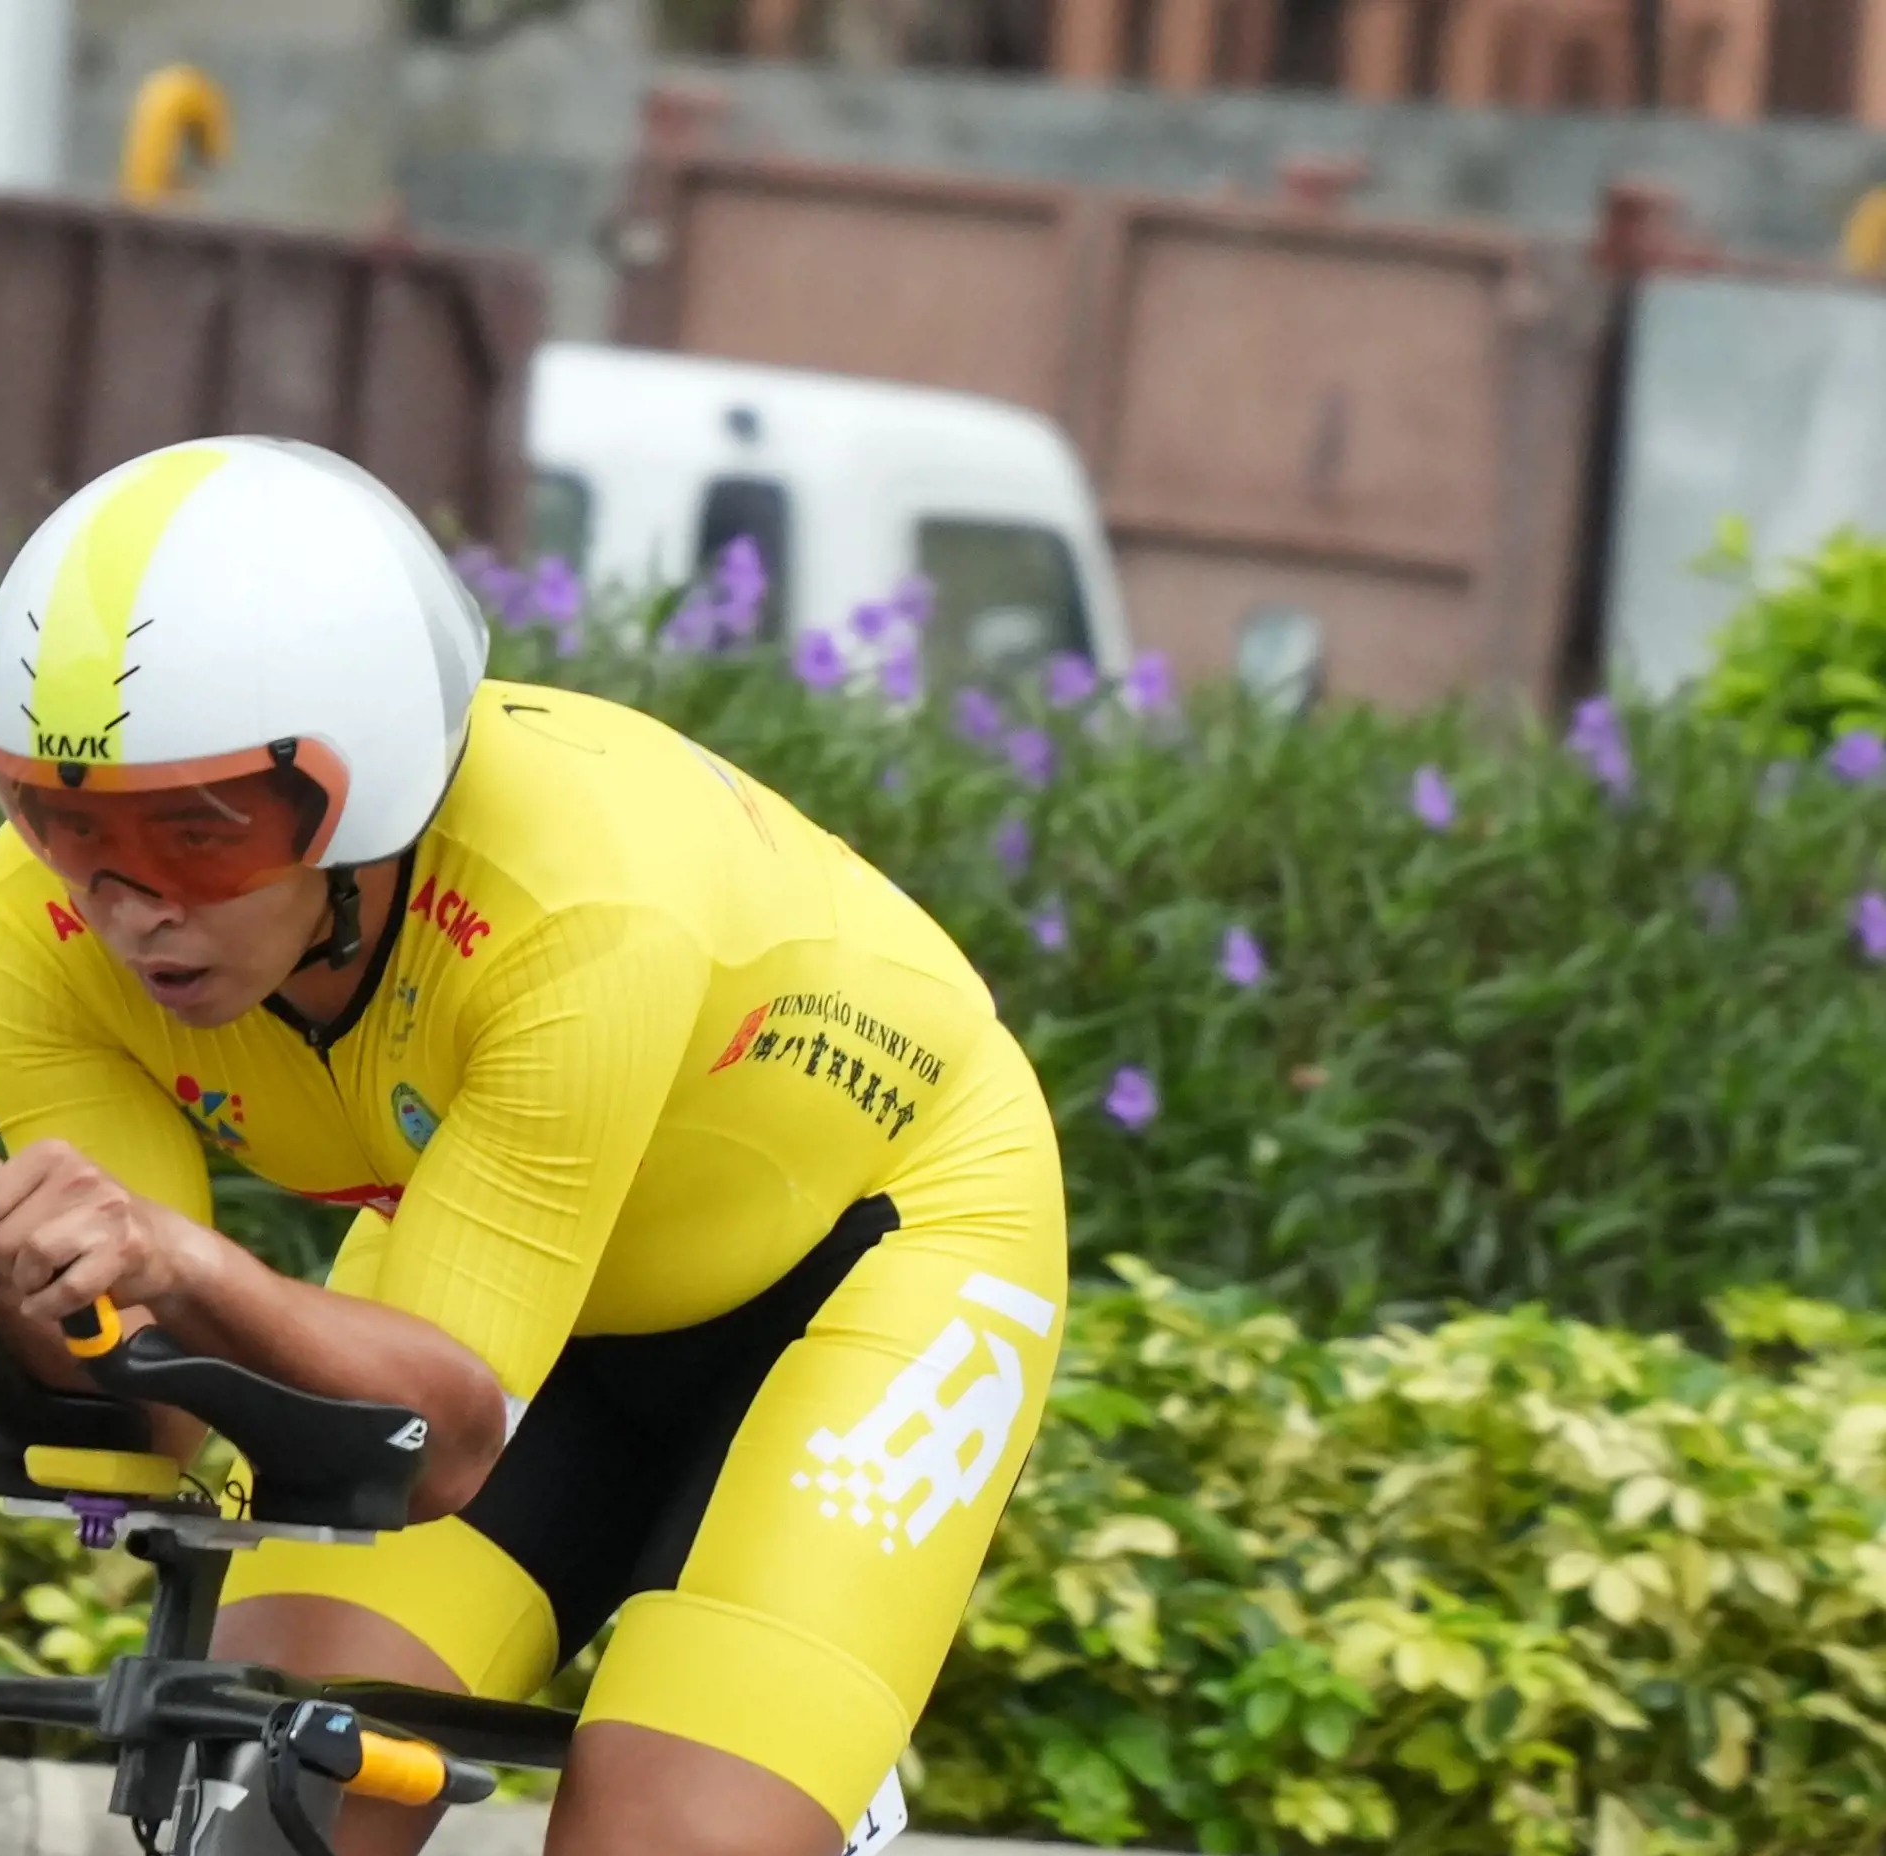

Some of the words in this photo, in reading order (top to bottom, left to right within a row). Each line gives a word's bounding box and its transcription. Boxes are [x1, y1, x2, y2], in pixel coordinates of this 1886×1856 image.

[46, 902, 88, 942] A
[410, 874, 490, 958] ACMC
[769, 991, 851, 1026] FUNDAÇÃO
[855, 1012, 911, 1063] HENRY
[909, 1045, 946, 1086] FOK
